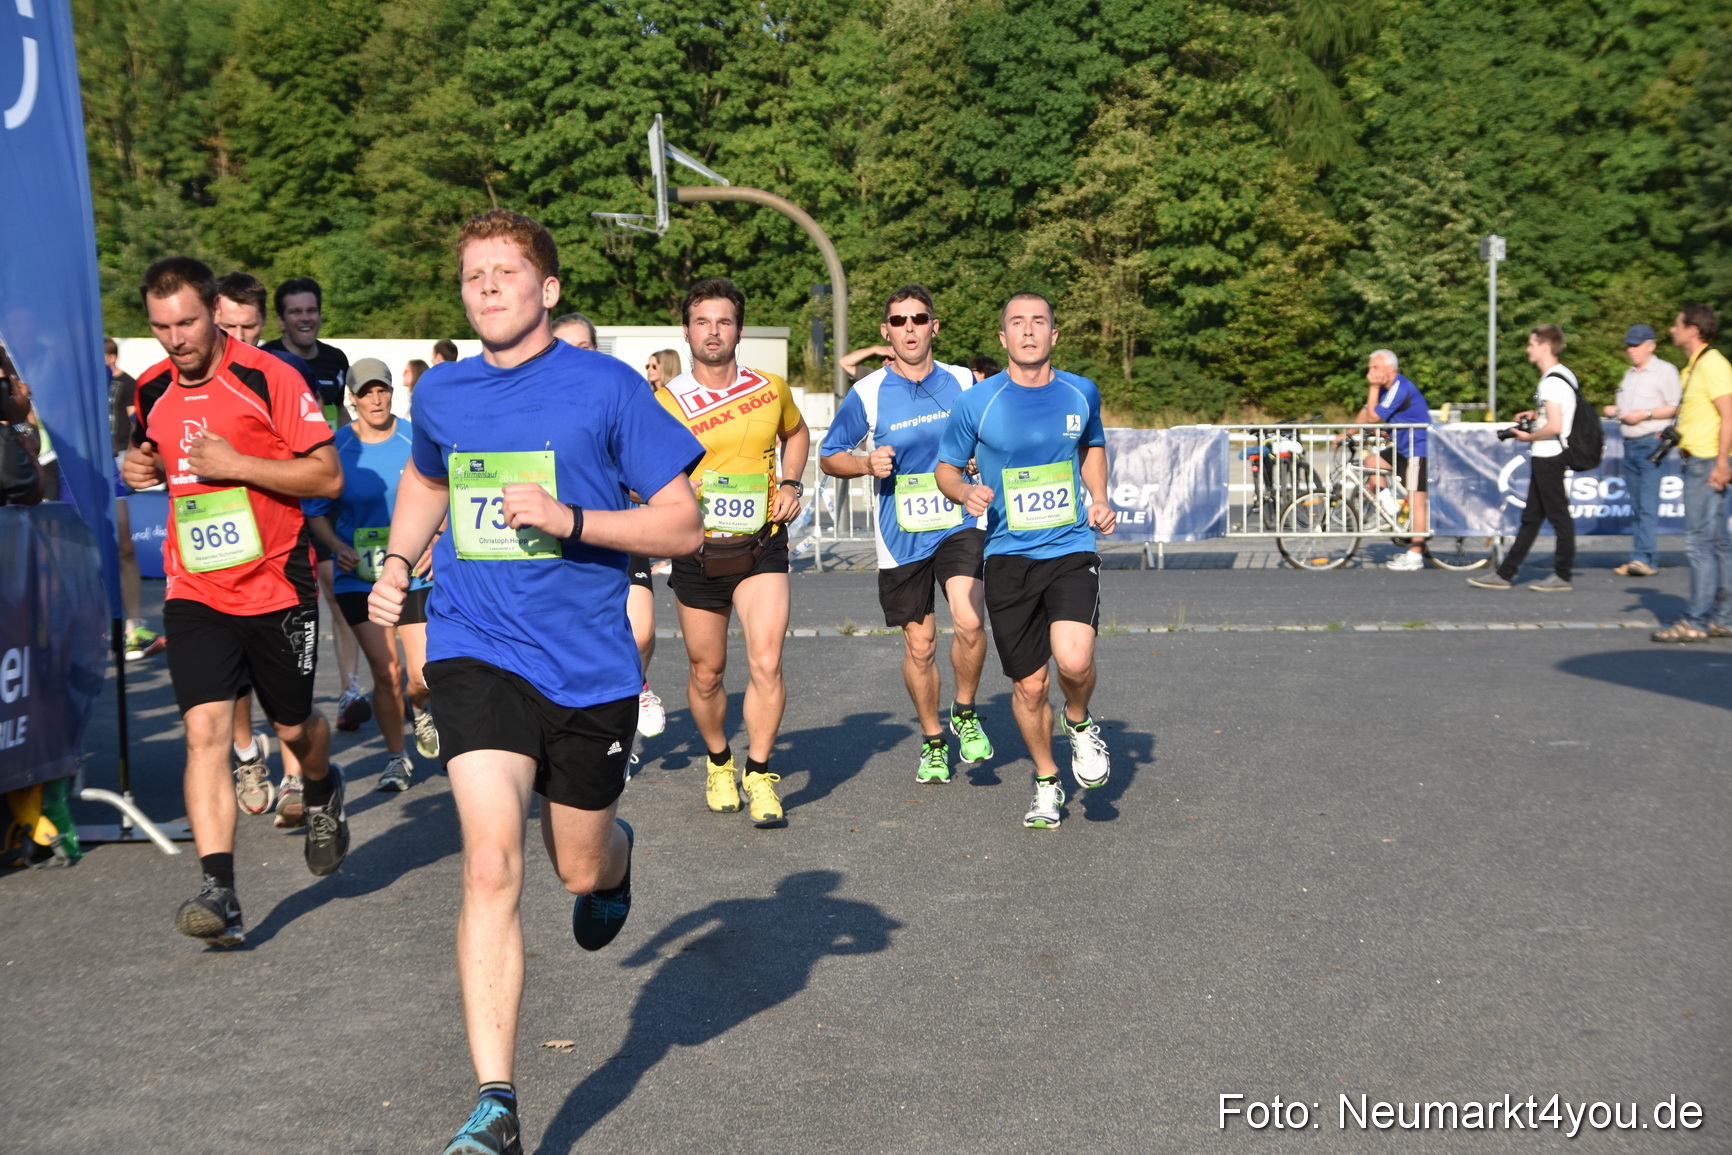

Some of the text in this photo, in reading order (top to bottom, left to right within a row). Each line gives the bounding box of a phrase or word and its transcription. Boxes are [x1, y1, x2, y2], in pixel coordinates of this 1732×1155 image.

[690, 390, 778, 436] MAX BÖGL
[714, 498, 754, 518] 898
[903, 495, 955, 516] 1316
[1013, 487, 1069, 513] 1282
[470, 496, 534, 530] 73
[1115, 511, 1147, 524] ILE
[190, 521, 240, 551] 968
[479, 537, 509, 545] Christoph
[362, 549, 387, 568] 12
